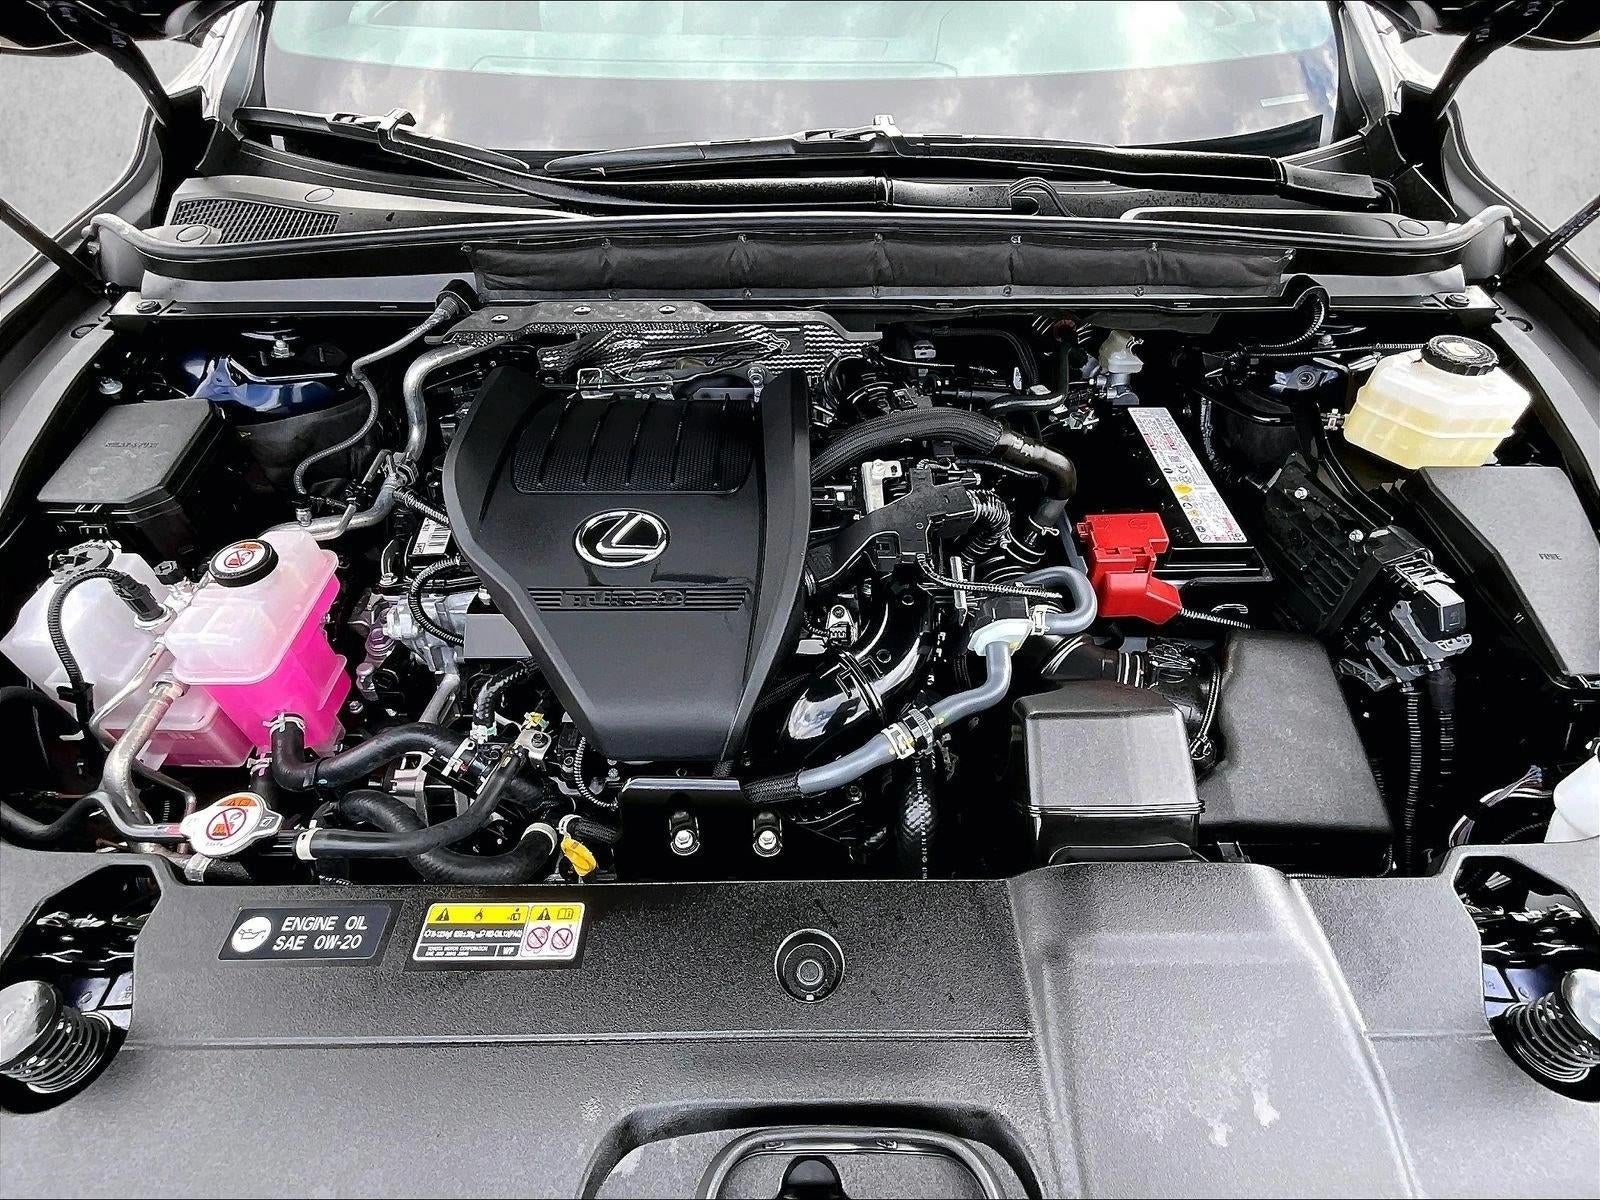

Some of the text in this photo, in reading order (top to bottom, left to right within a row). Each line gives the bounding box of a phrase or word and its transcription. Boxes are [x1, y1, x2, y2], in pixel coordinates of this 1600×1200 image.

[281, 915, 368, 931] ENGINE OIL
[272, 934, 363, 951] SAE 0W-20
